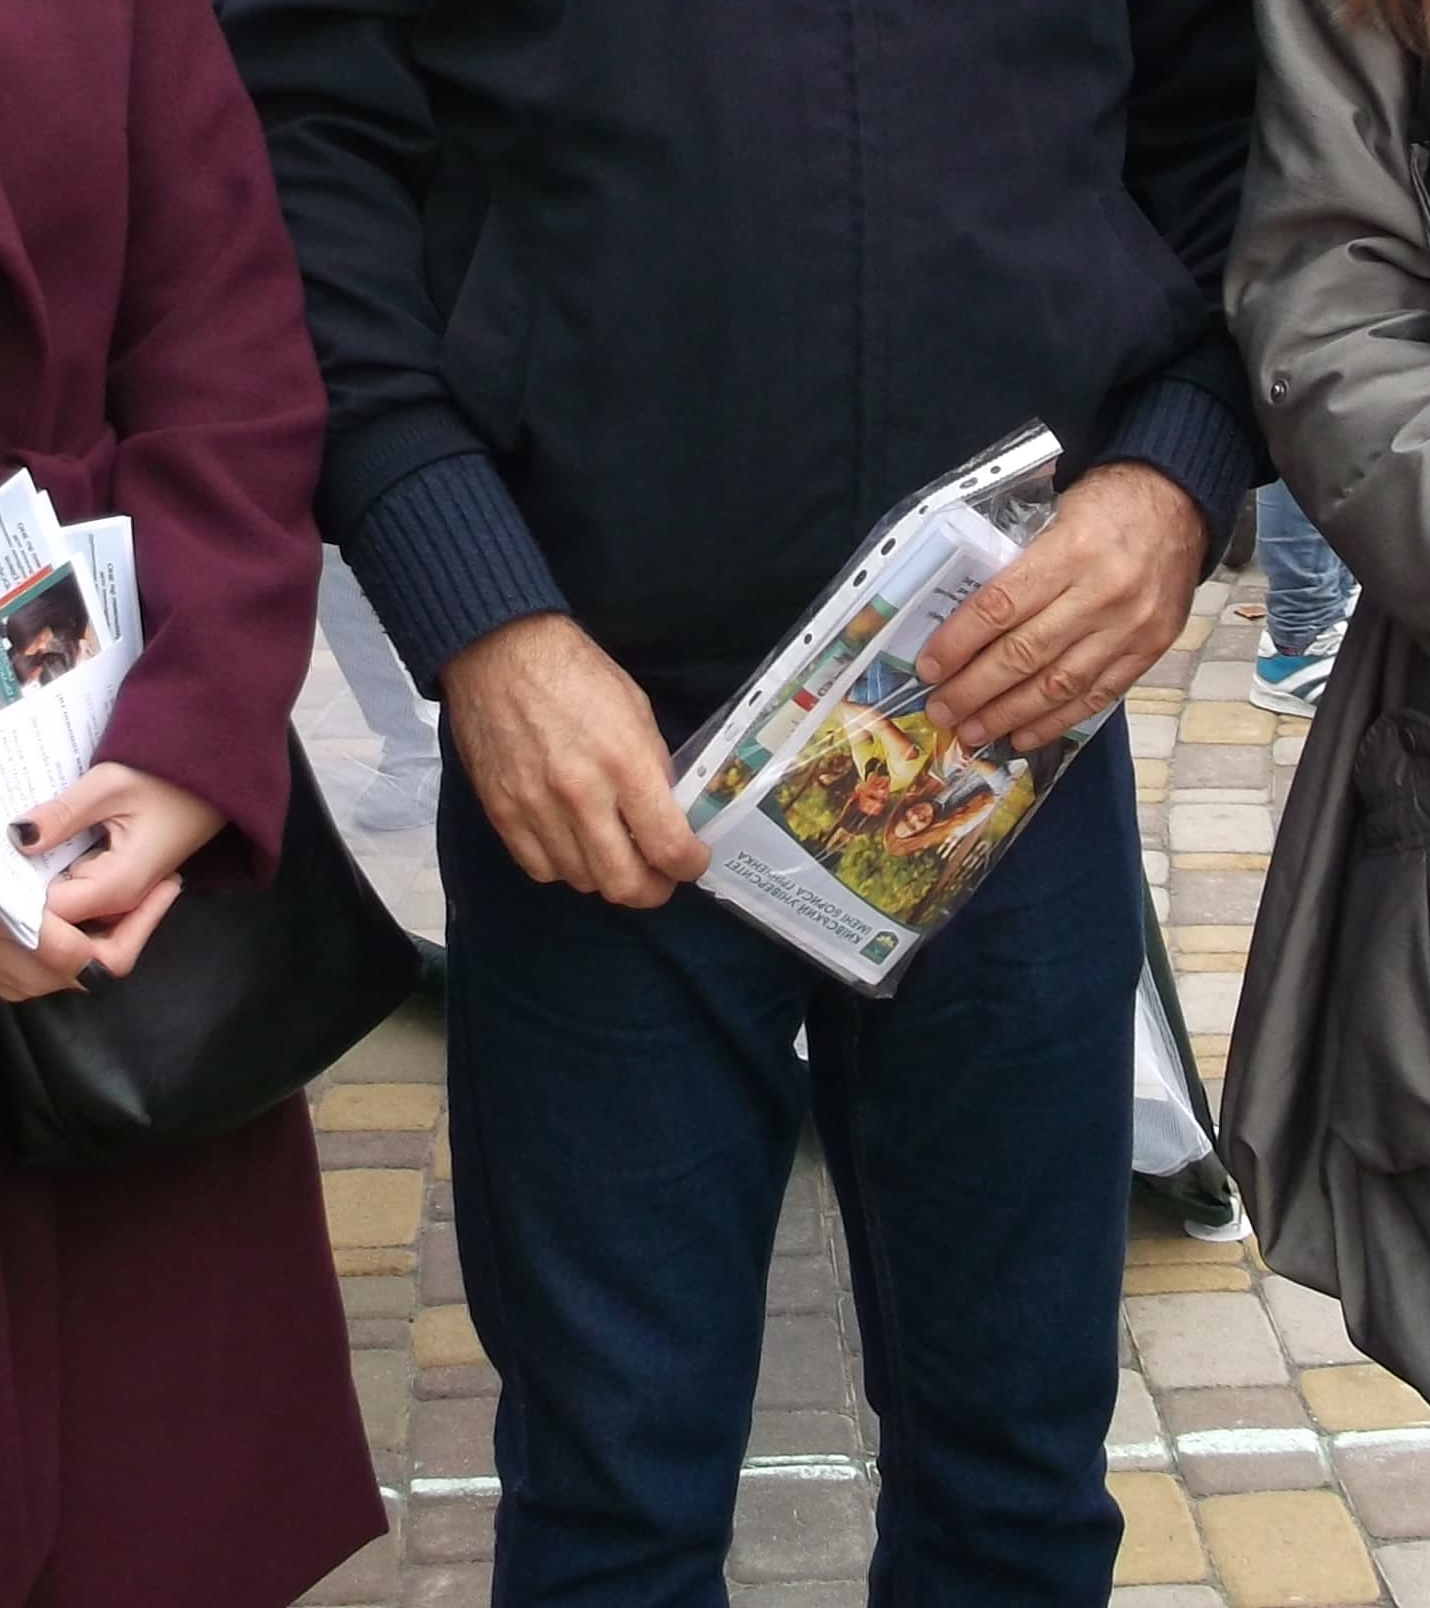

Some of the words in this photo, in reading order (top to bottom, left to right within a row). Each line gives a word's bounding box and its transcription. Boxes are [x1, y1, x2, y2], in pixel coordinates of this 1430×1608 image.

[723, 857, 801, 909] УНІВЕРСИТЕТ
[794, 885, 843, 917] БОРИСА
[795, 902, 864, 947] КИЇВСЬКИЙ
[839, 912, 873, 936] ІМЕНІ
